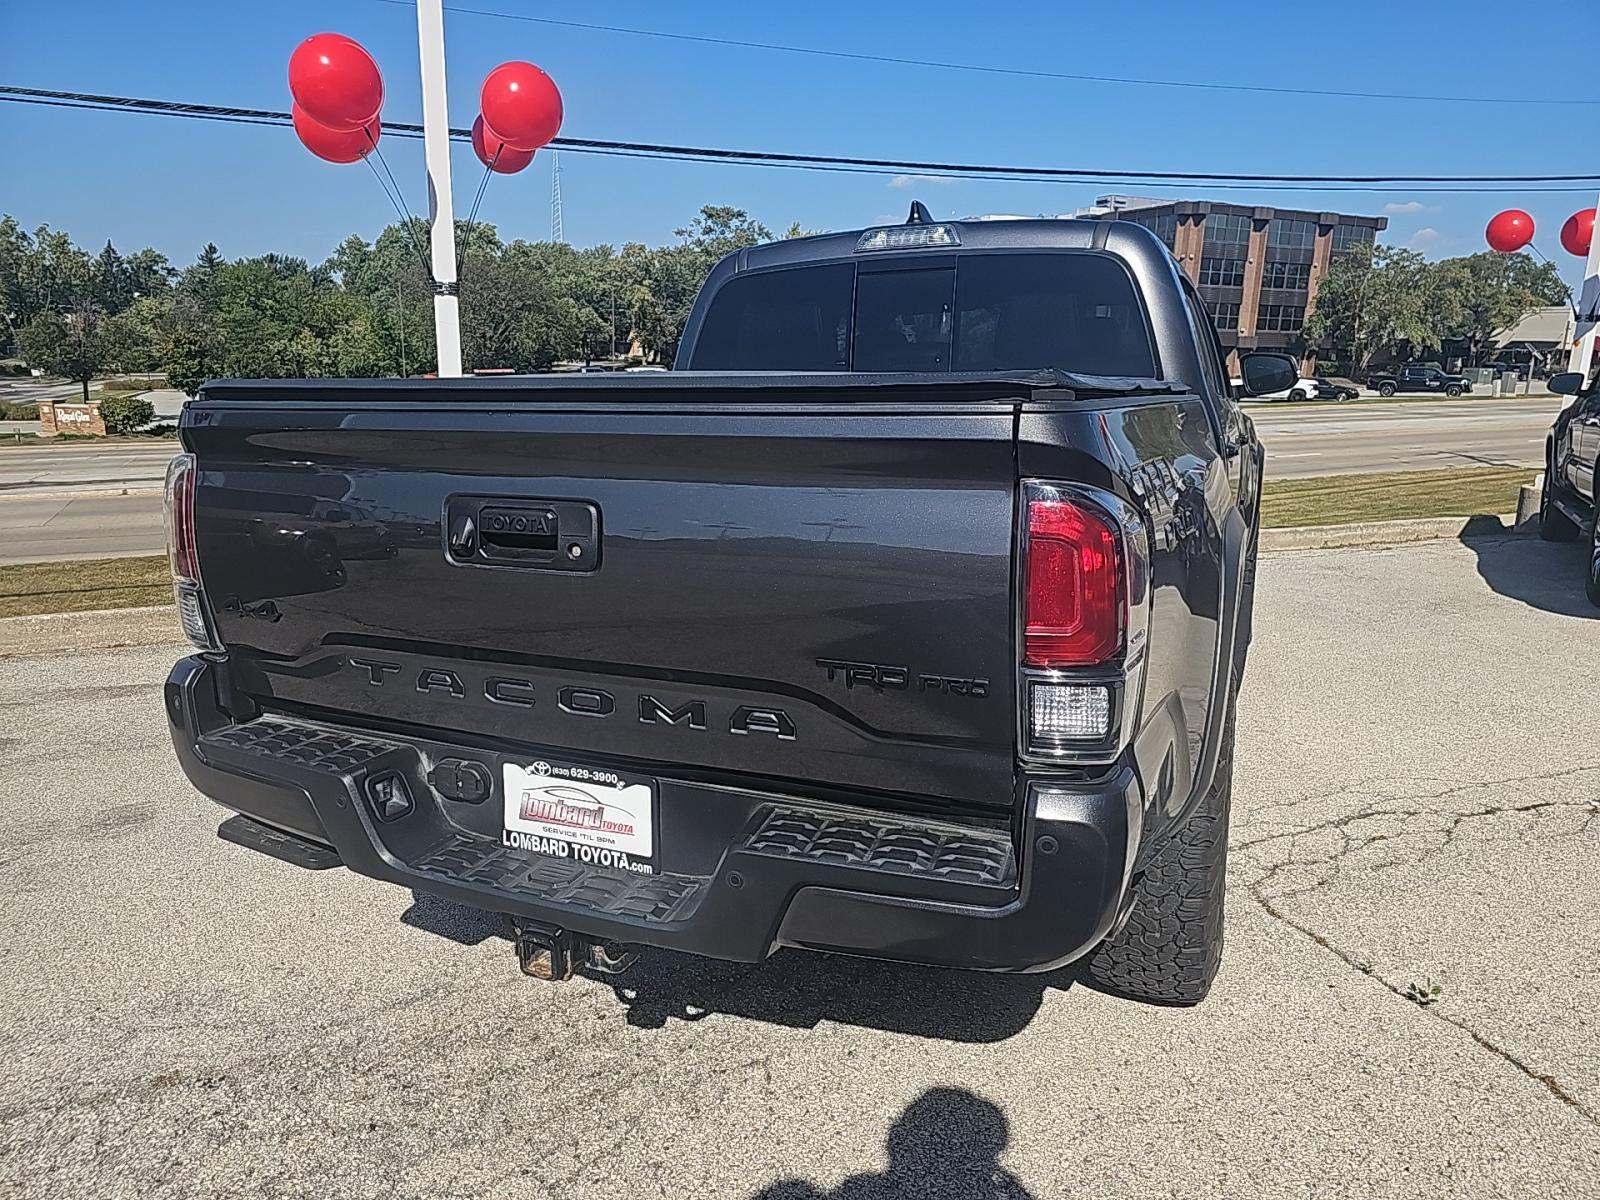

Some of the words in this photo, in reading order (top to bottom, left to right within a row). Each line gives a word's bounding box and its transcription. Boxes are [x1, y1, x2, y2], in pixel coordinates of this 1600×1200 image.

[483, 515, 550, 534] TOYOTA
[815, 656, 910, 692] TRD
[918, 673, 991, 698] PRO
[348, 656, 799, 742] TACOMA
[570, 767, 618, 784] 629-3900
[519, 791, 605, 829] lombard
[602, 820, 634, 834] TOYOTA
[542, 826, 578, 839] SERVICE
[502, 829, 569, 858] LOMBARD
[571, 843, 653, 875] TOYOTA.com
